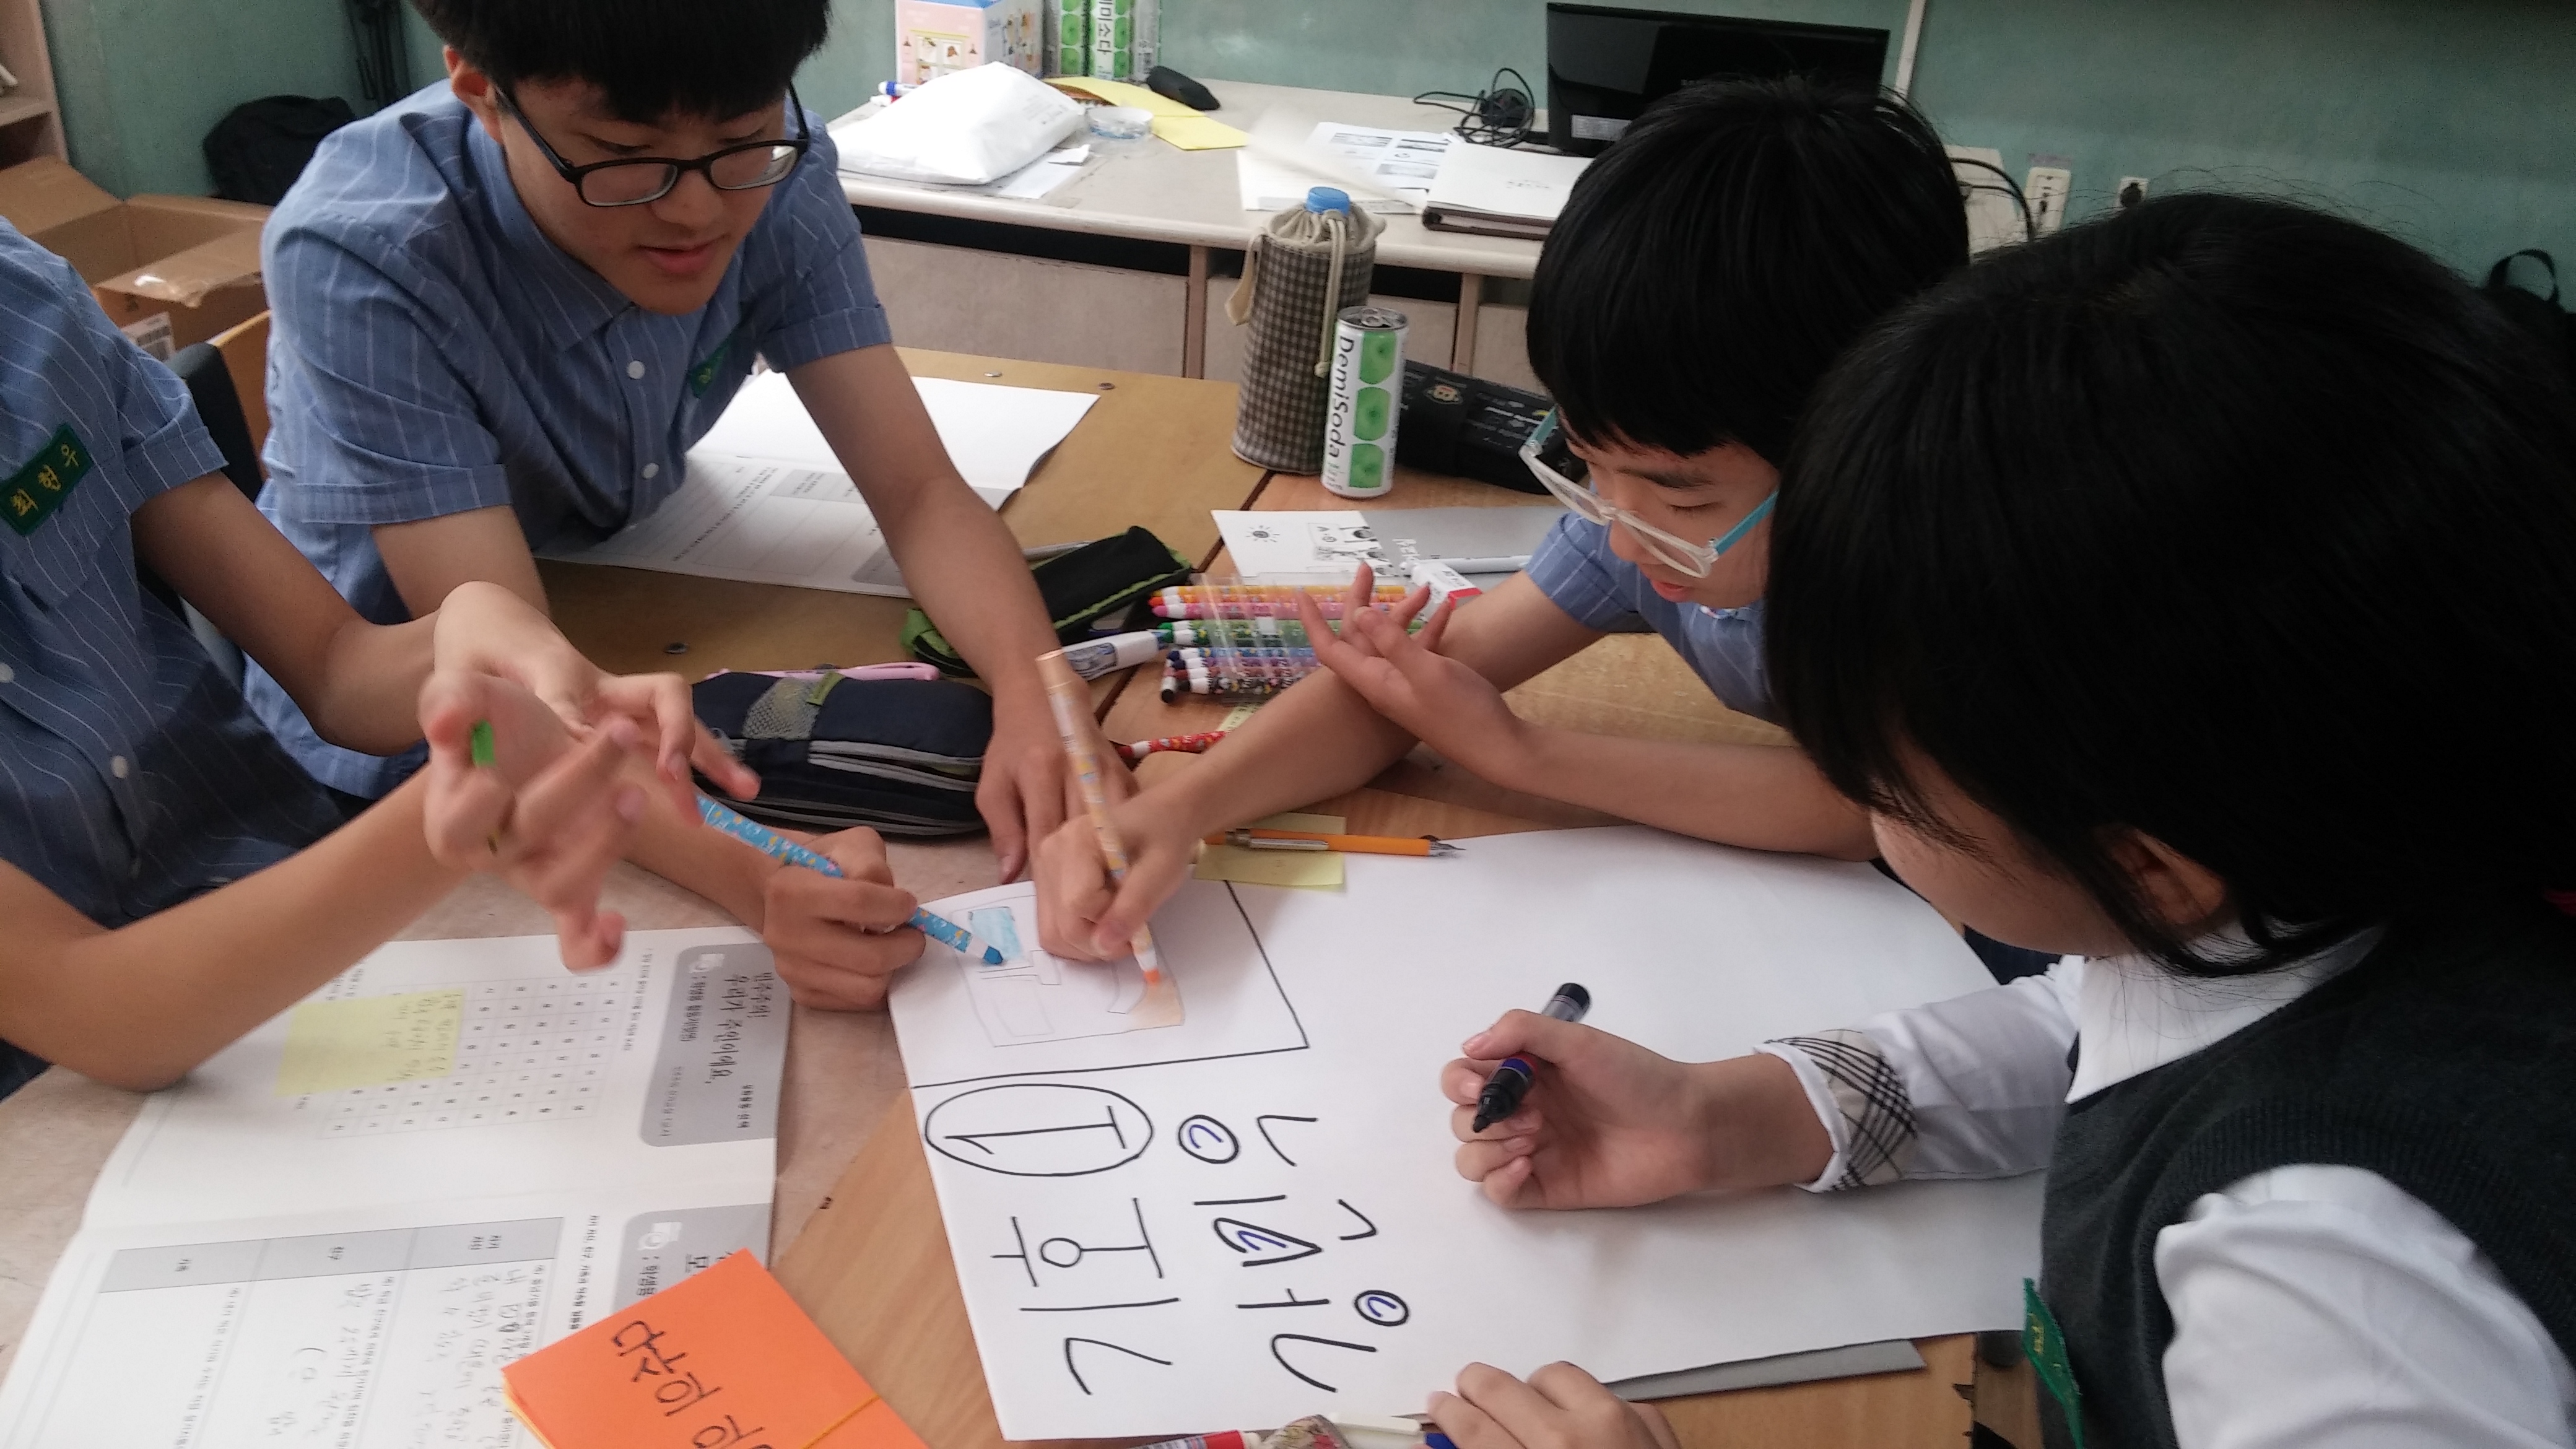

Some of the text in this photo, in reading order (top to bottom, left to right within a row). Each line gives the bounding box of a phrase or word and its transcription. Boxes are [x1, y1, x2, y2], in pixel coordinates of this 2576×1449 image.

[1328, 335, 1355, 458] DemiSoda
[718, 973, 751, 1012] 우리가
[747, 972, 774, 1018] 민주주의!
[991, 1196, 1182, 1395] 기호
